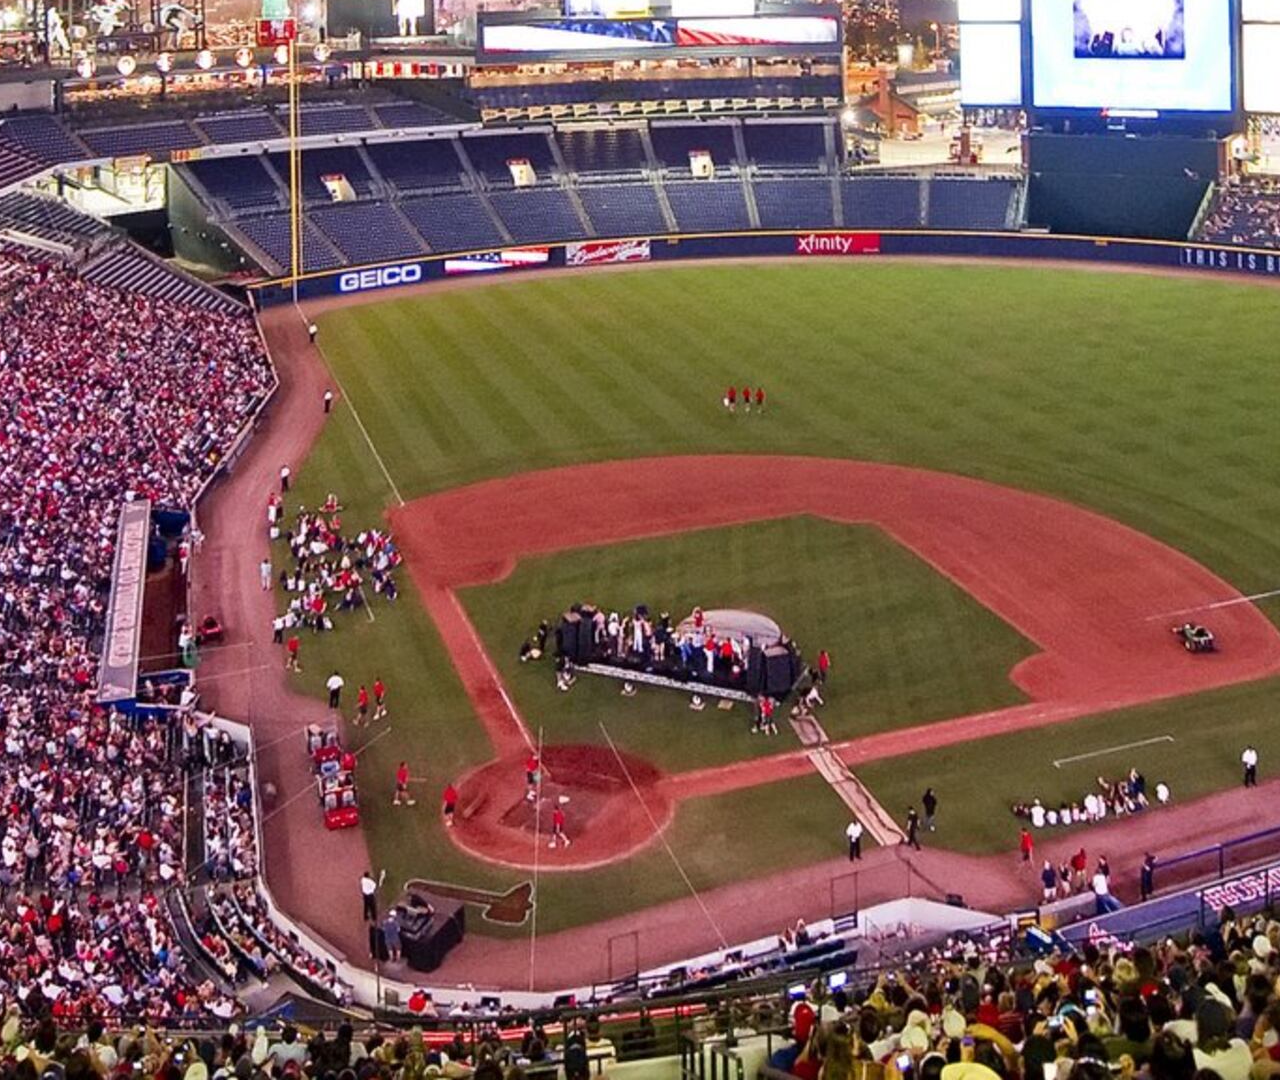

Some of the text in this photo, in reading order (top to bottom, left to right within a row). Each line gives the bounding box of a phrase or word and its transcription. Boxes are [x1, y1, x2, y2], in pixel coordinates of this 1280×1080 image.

[798, 233, 853, 253] xfinity
[1185, 248, 1228, 267] THIS
[1238, 251, 1256, 269] IS
[340, 263, 422, 292] GEICO
